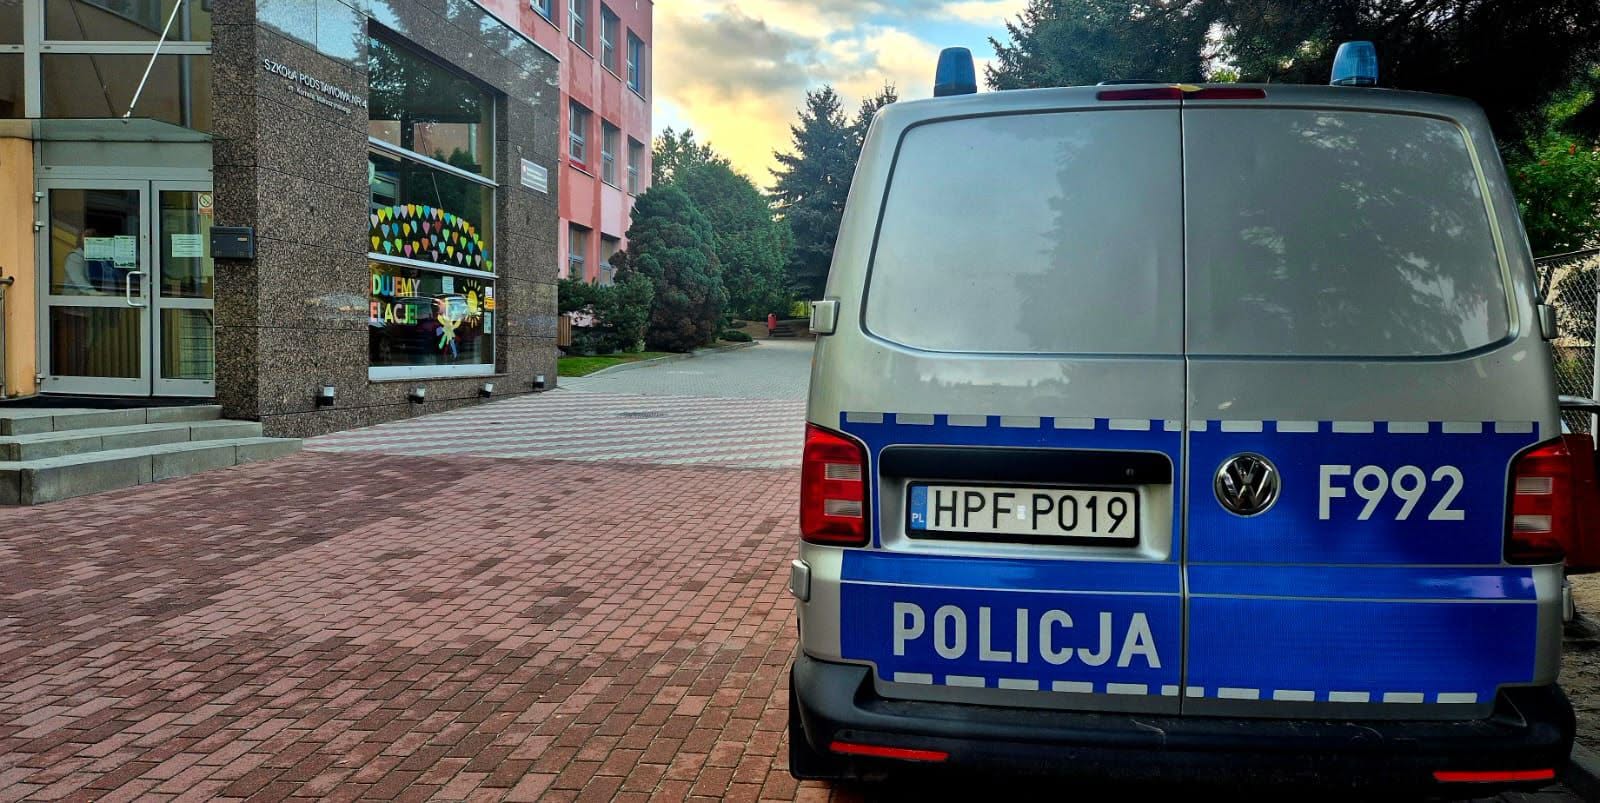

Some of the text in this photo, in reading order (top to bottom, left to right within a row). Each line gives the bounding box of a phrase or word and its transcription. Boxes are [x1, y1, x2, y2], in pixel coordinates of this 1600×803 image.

[264, 58, 297, 81] SZKOŁA
[299, 73, 350, 103] PODSTAWOWA
[934, 489, 1128, 534] HPF P019
[1318, 464, 1465, 521] F992
[911, 512, 925, 524] PL
[893, 601, 1162, 669] POLICJA
